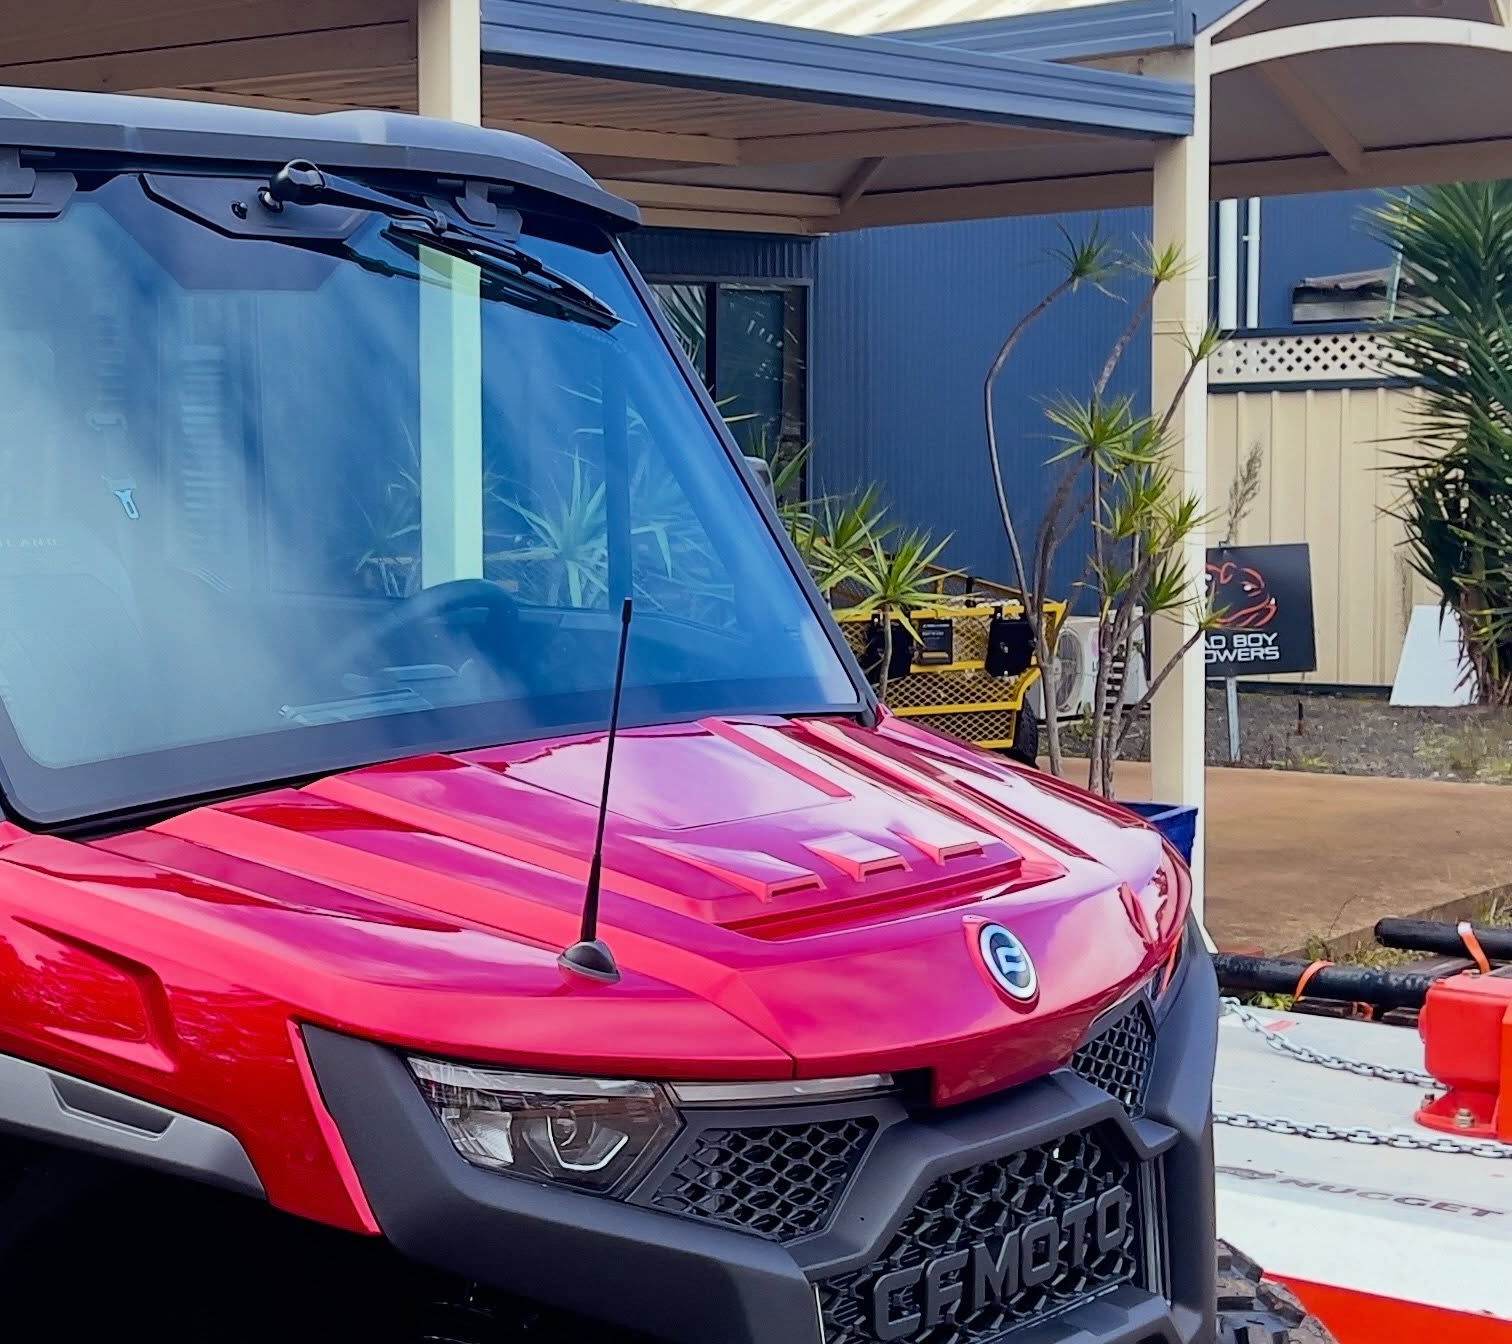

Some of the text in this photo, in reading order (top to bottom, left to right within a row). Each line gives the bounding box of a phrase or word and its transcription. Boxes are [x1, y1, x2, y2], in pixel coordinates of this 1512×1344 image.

[1233, 632, 1278, 648] BOY
[1279, 1176, 1505, 1218] NUGGET
[873, 1184, 1128, 1342] CFMOTO
